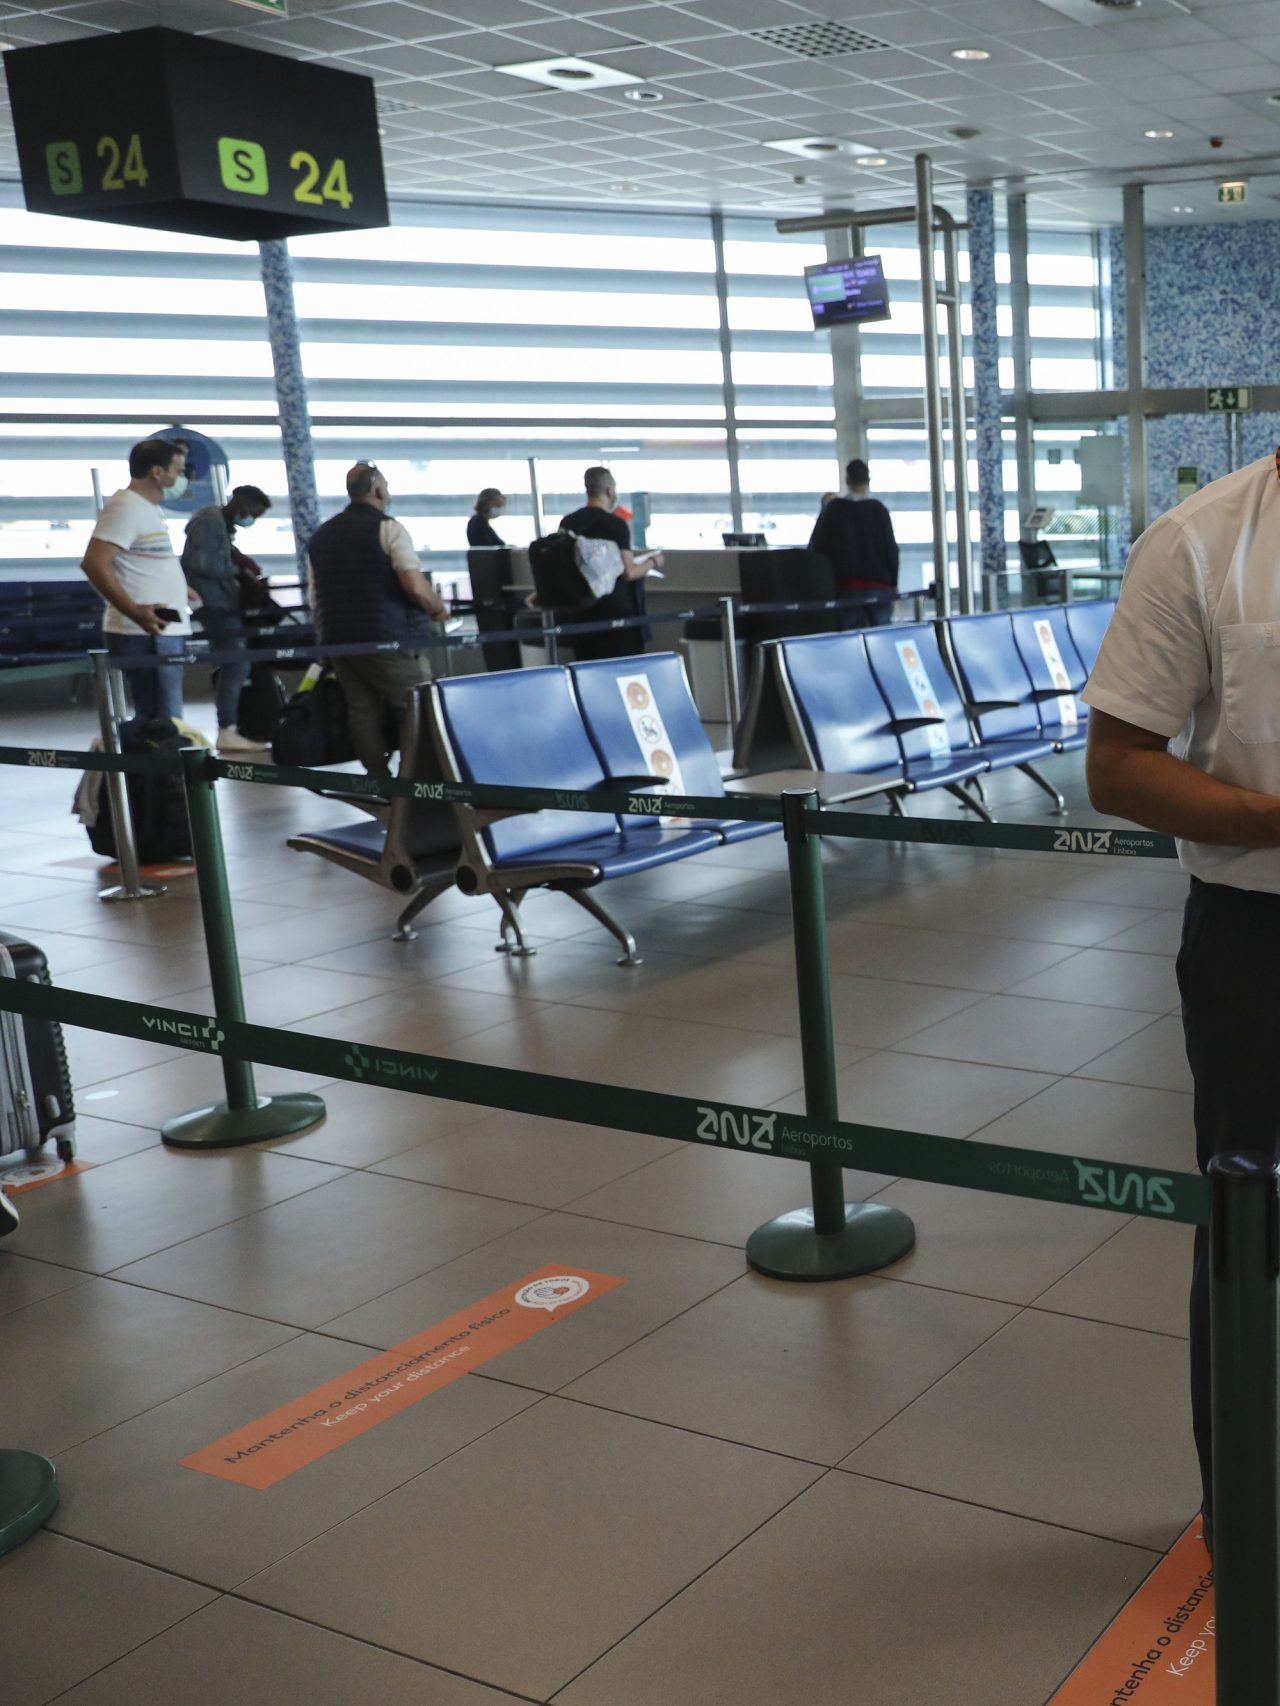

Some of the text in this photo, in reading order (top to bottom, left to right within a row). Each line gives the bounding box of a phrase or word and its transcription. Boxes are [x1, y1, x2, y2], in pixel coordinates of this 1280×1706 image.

[56, 134, 149, 191] S 24
[233, 150, 353, 209] S 24
[1114, 837, 1154, 848] Aeroportos
[142, 1016, 198, 1038] VINCI
[781, 1126, 853, 1150] Aeroportos
[224, 1408, 327, 1463] Mantenha
[329, 1400, 342, 1409] o
[344, 1329, 471, 1400] distanciamento
[320, 1345, 471, 1428] Keep your distance
[1157, 1636, 1171, 1647] o
[1166, 1616, 1216, 1677] Keep yo
